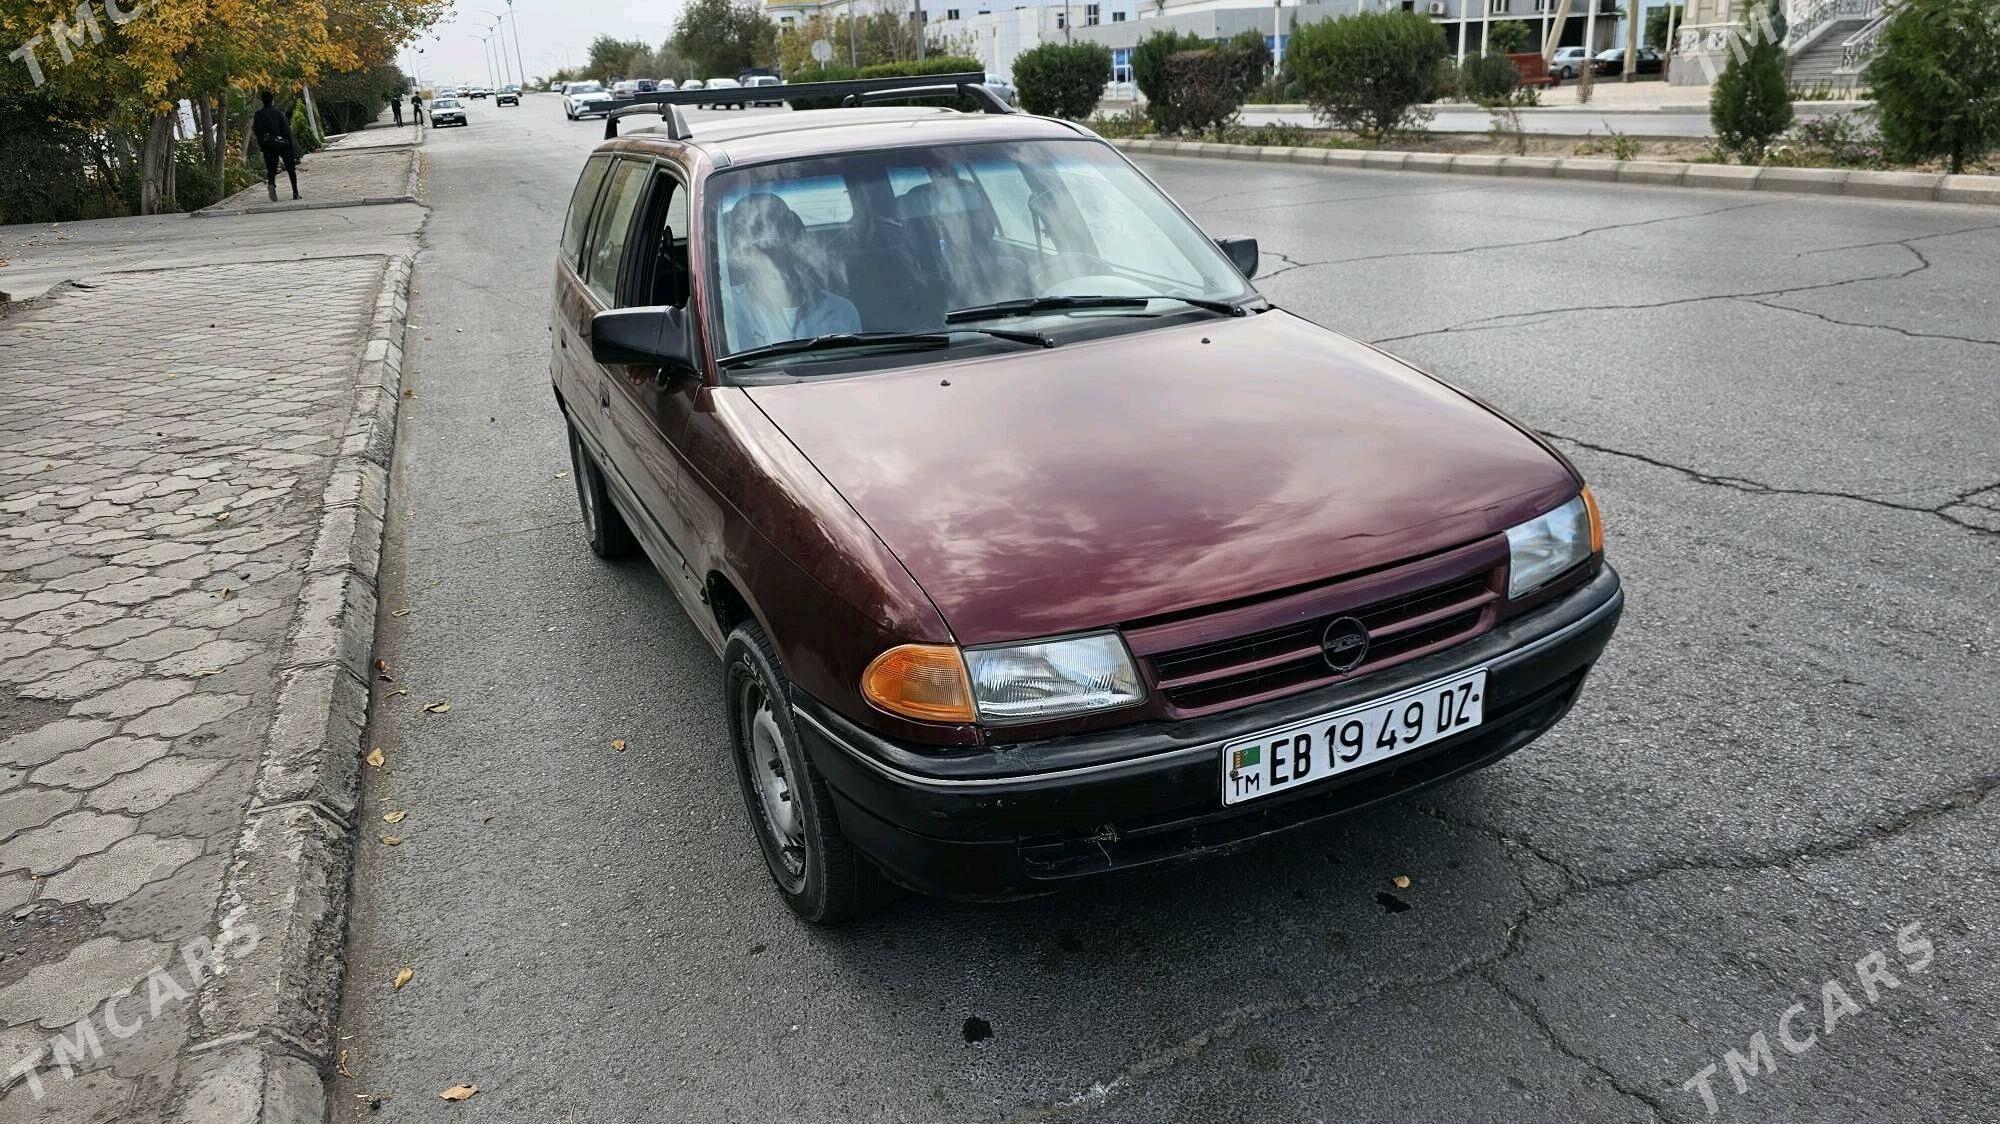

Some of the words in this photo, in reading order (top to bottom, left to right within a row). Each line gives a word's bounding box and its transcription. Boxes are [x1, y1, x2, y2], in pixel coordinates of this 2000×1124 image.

[1270, 733, 1312, 787] EB
[1324, 720, 1364, 769] 19
[1376, 701, 1424, 750] 49
[1437, 681, 1474, 734] DZ
[1232, 772, 1260, 797] TM
